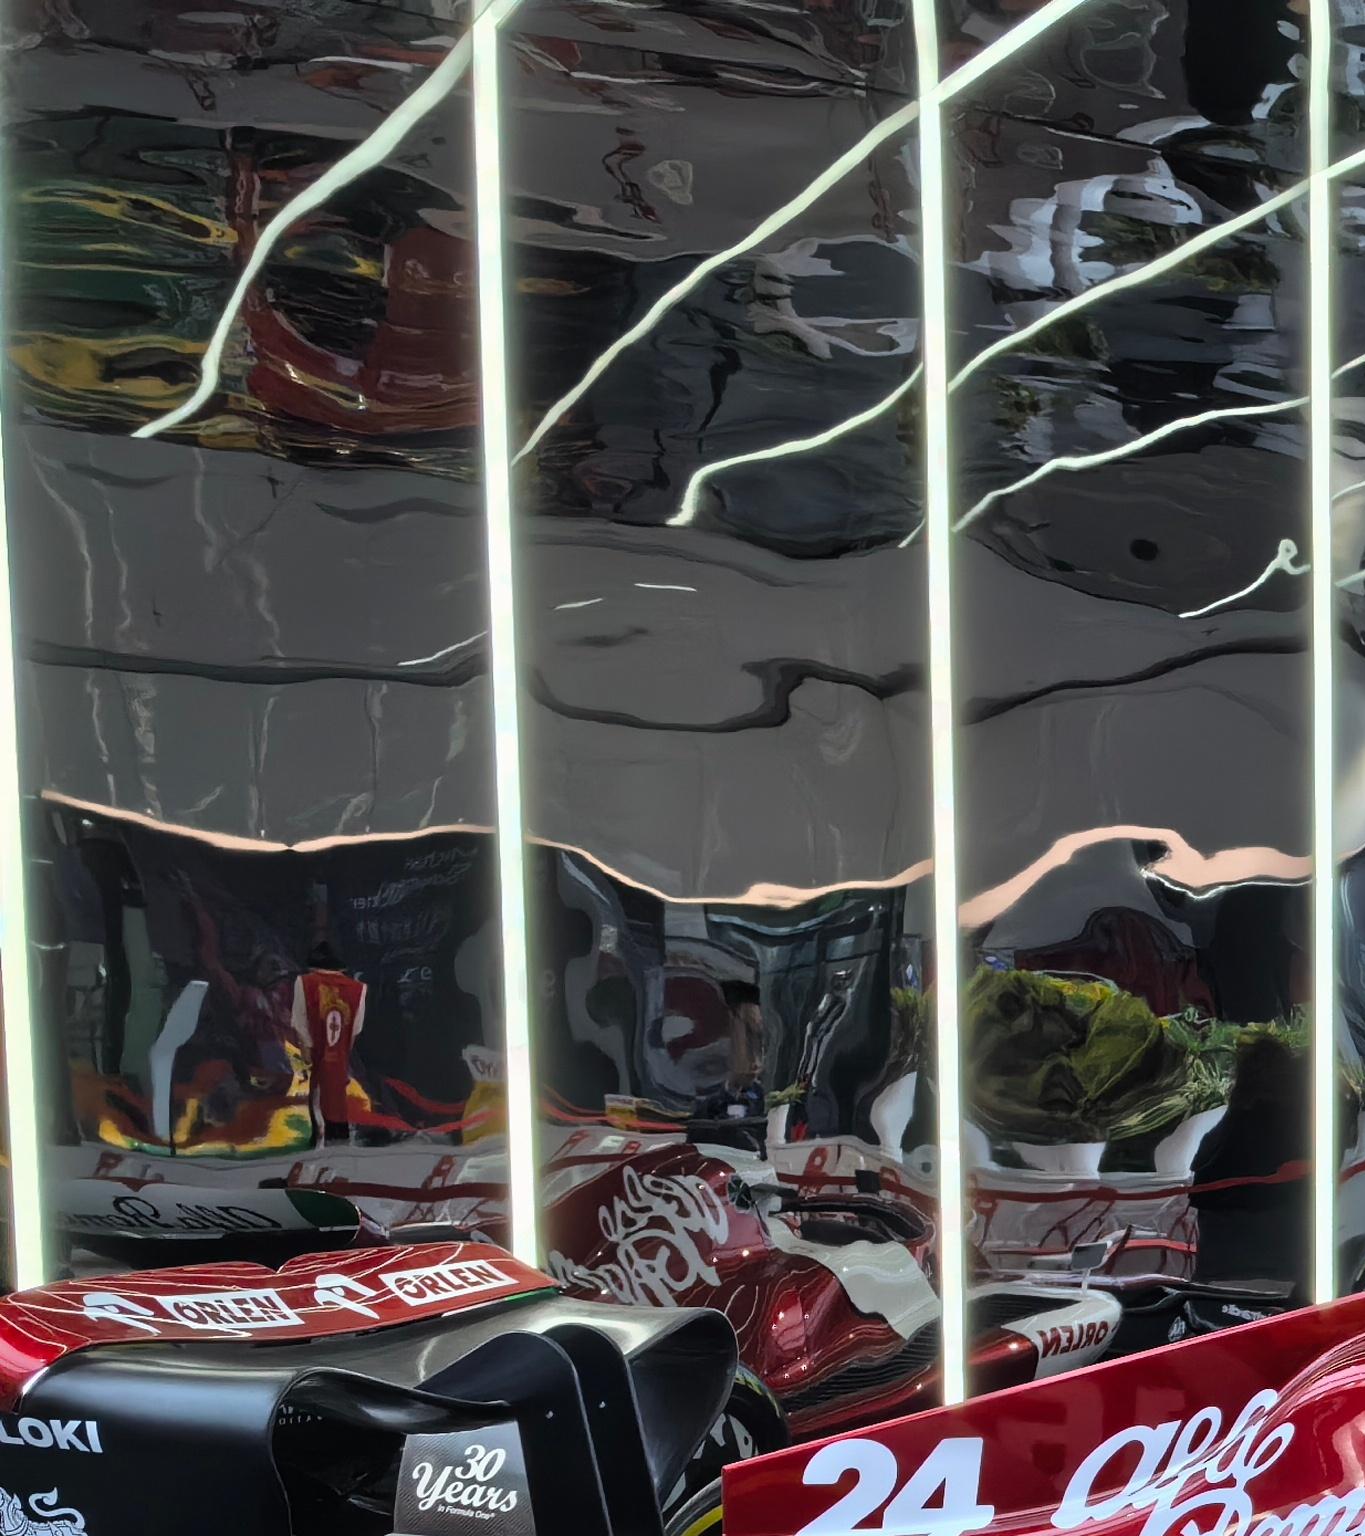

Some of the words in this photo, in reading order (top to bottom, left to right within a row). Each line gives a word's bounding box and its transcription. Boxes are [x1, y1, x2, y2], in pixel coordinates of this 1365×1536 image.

[172, 1297, 289, 1325] ORLEN
[396, 1264, 506, 1301] ORLEN
[412, 1462, 518, 1512] Years
[455, 1445, 506, 1482] 30
